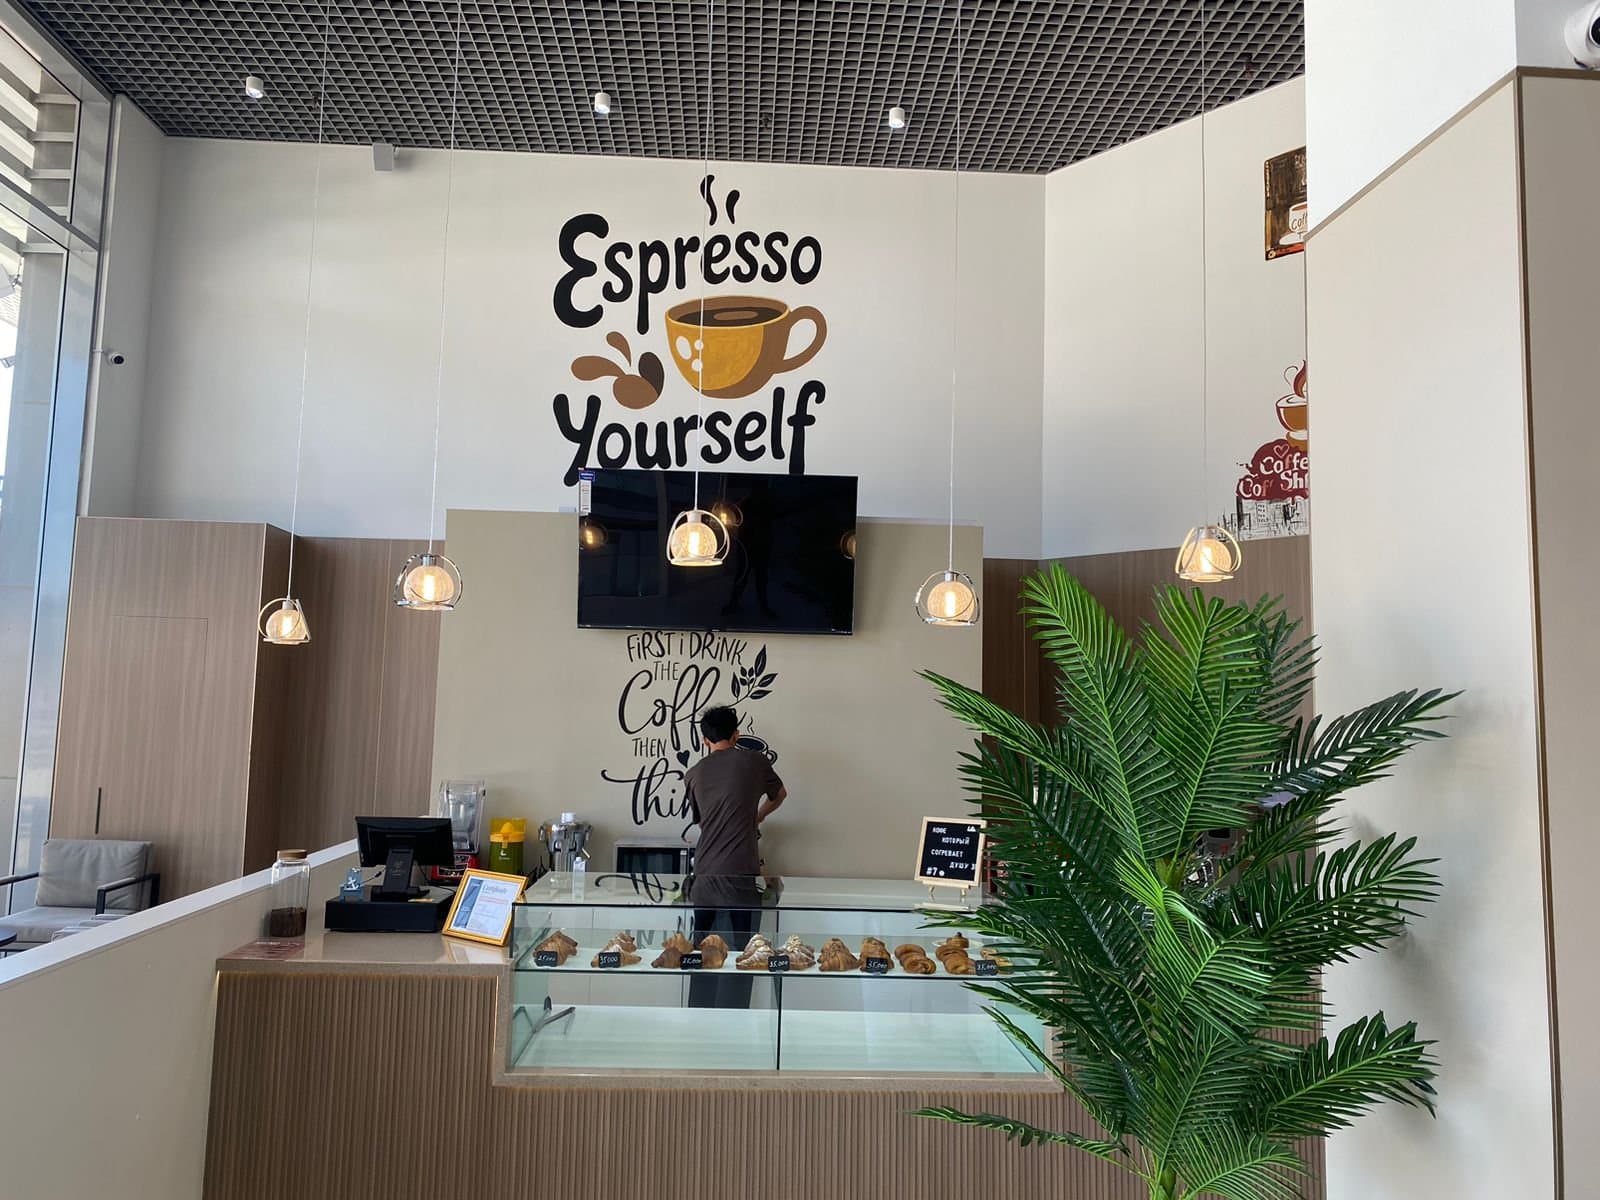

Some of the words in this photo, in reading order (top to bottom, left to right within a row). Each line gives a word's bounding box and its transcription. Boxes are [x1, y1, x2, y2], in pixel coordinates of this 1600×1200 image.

[553, 213, 822, 335] Espresso
[553, 380, 826, 487] Yourself
[1280, 470, 1308, 491] Sh
[653, 661, 679, 681] THE
[632, 738, 667, 758] THEN
